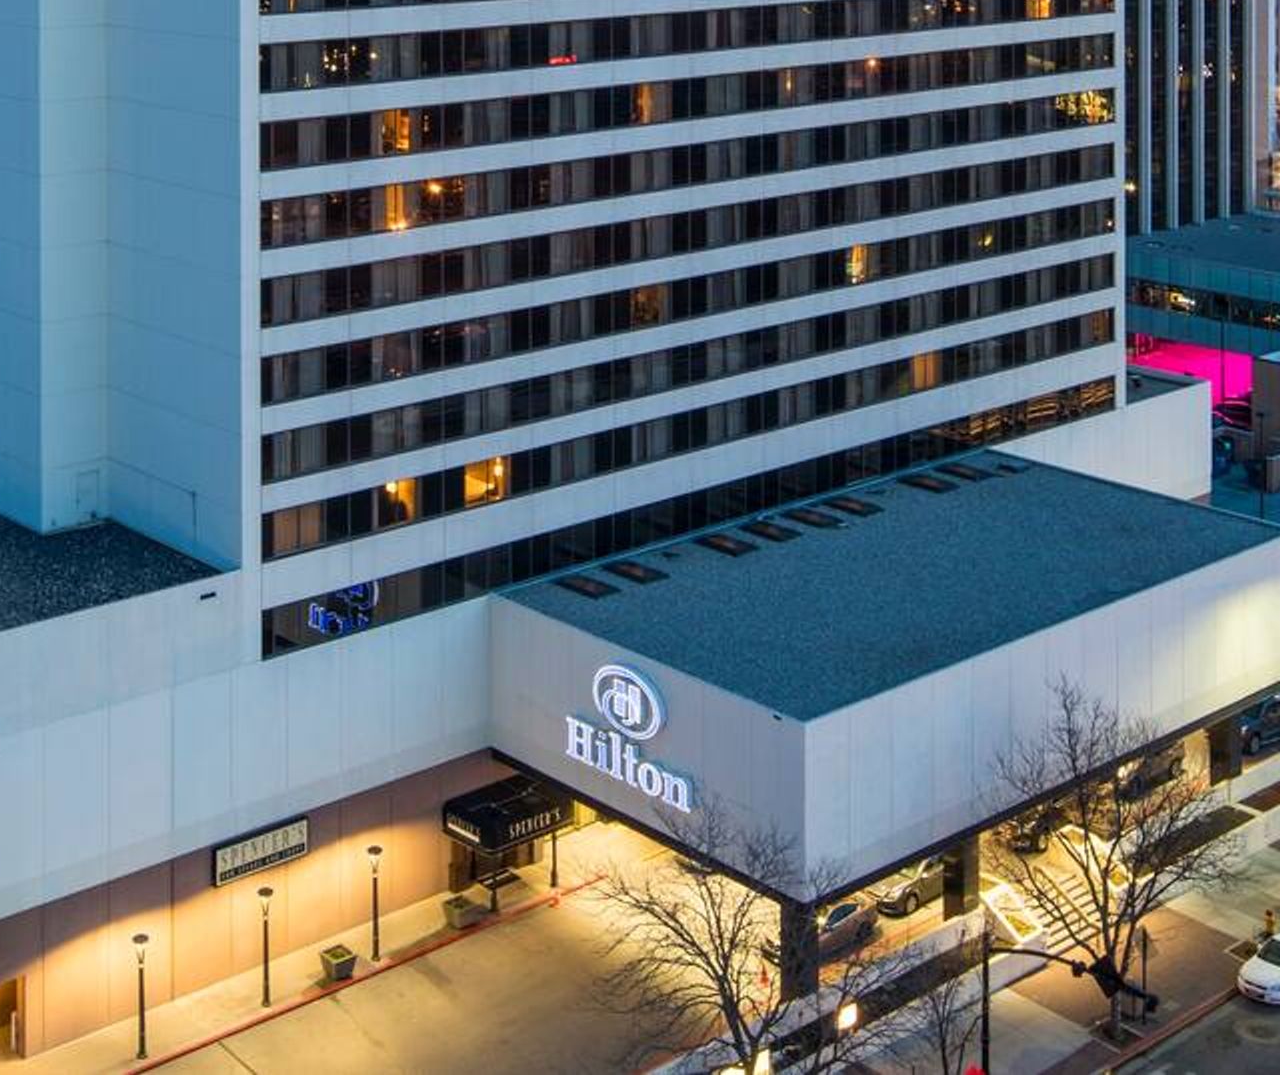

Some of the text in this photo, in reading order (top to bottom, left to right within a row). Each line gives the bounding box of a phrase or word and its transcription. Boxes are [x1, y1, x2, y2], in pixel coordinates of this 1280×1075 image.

[565, 715, 692, 814] Hilton
[221, 823, 305, 868] SPENCER'S
[509, 807, 561, 840] SPENCER'S
